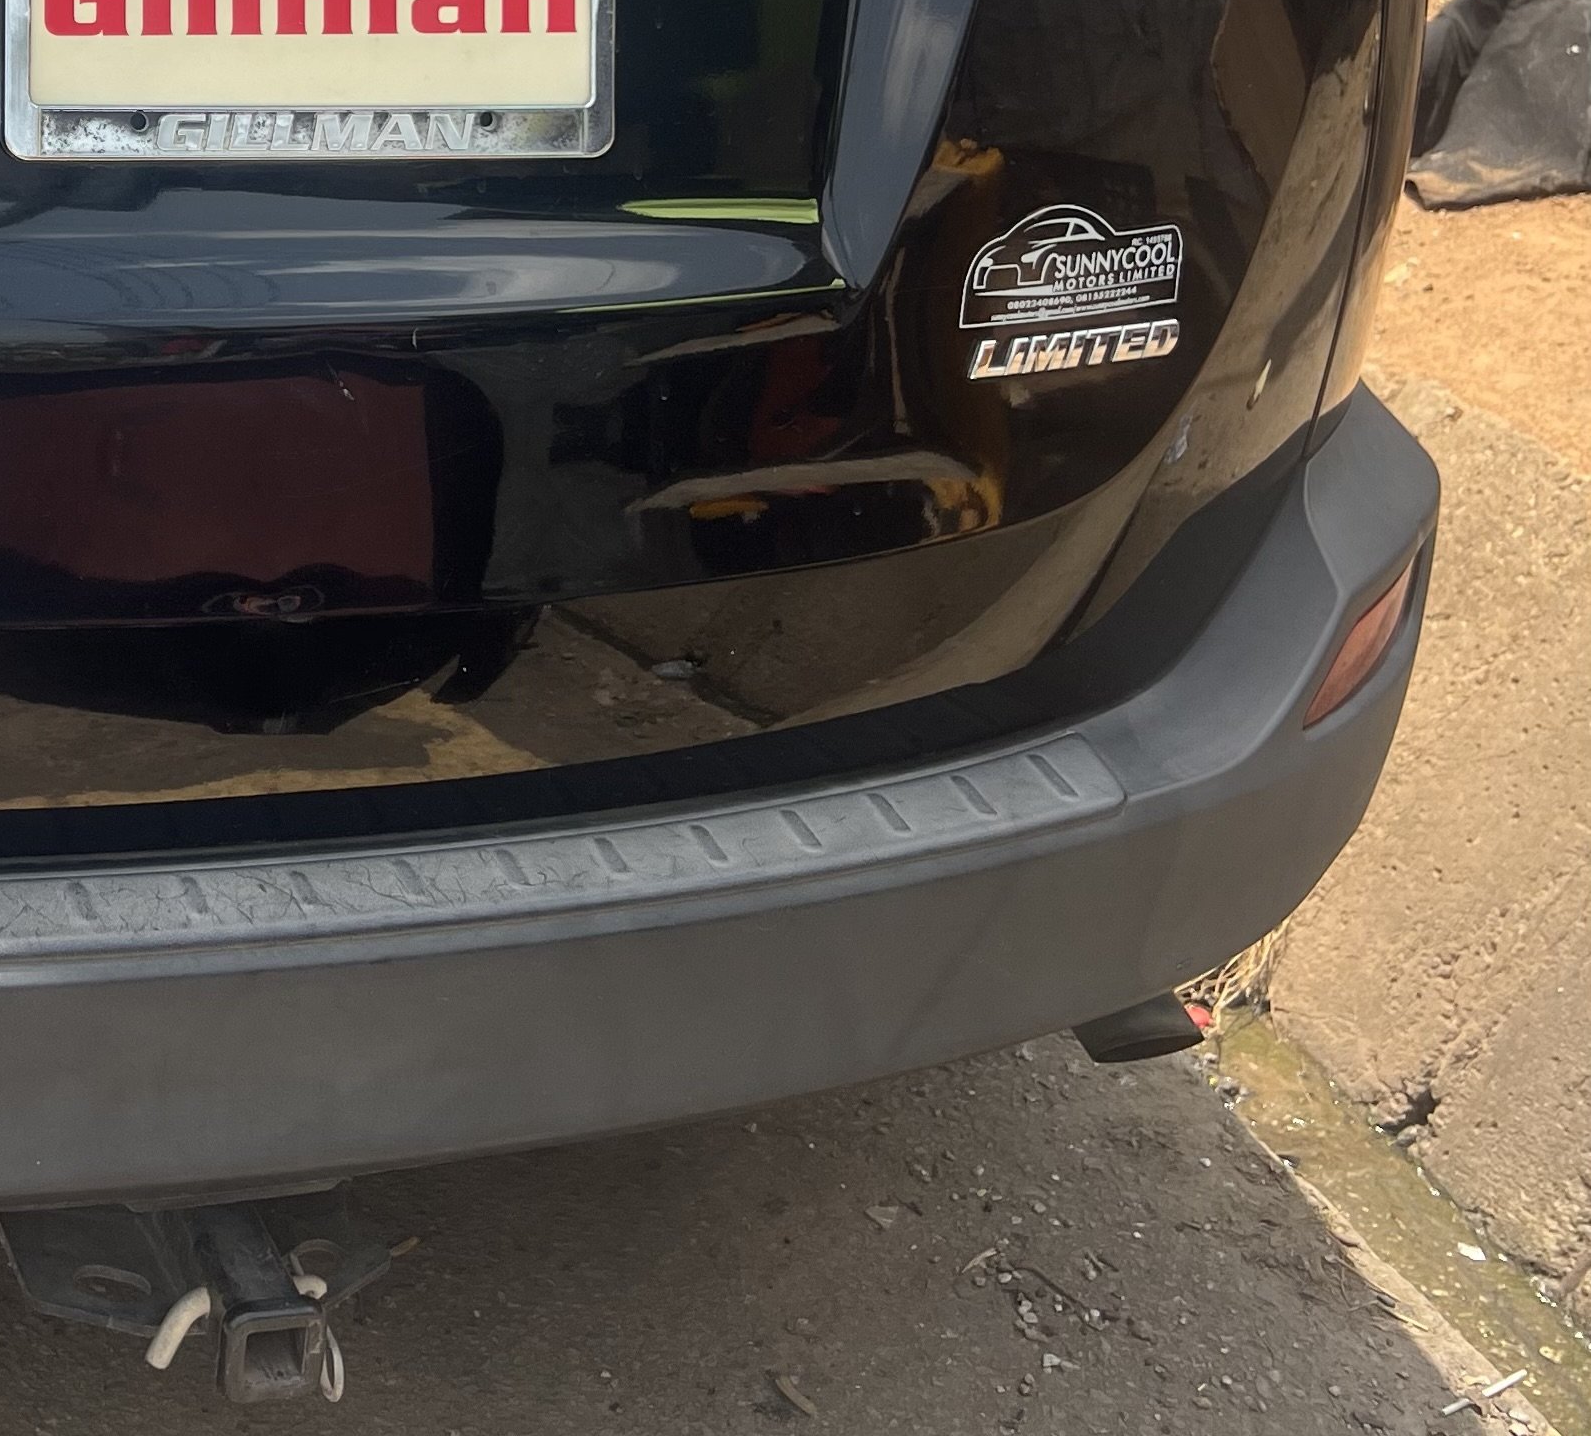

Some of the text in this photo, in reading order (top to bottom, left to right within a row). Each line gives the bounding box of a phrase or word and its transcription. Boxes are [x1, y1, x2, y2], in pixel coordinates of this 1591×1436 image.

[156, 112, 476, 152] GILLMAN
[1053, 264, 1176, 292] MOTORS LIMITED
[1054, 242, 1176, 279] SUNNYCOOL
[968, 318, 1180, 379] LIMITED
